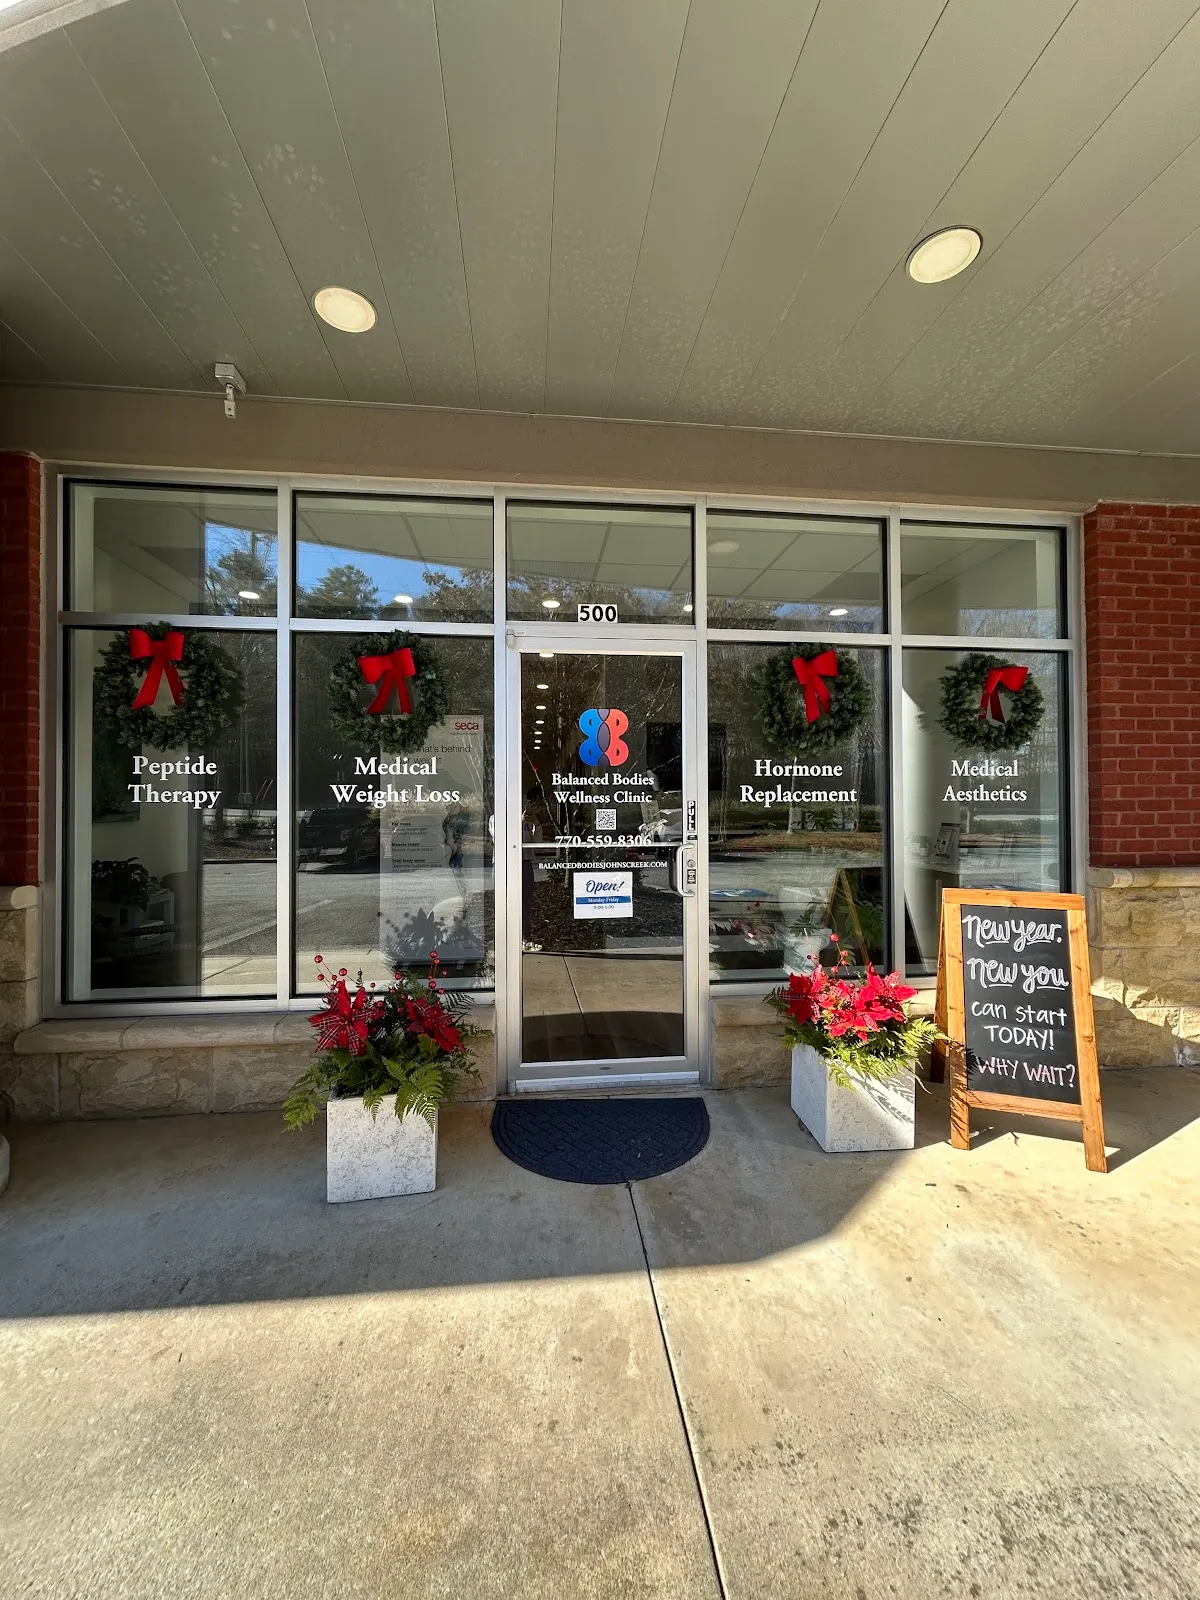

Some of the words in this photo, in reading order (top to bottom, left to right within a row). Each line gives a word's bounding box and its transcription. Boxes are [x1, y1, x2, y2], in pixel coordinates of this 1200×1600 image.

[580, 605, 616, 622] 500
[454, 722, 479, 730] seca
[414, 744, 439, 753] hat's
[441, 744, 471, 753] behind
[132, 755, 217, 781] Peptide
[354, 756, 437, 775] Medical
[754, 759, 843, 777] Hormone
[951, 760, 1019, 777] Medical
[551, 773, 609, 785] Balanced
[612, 773, 654, 785] Bodies
[127, 783, 222, 809] Therapy
[329, 784, 409, 808] Weight
[415, 784, 460, 803] Loss
[553, 791, 610, 803] Wellness
[613, 791, 652, 803] Clinic
[740, 784, 857, 807] Replacement
[942, 784, 1027, 801] Aesthetics
[555, 835, 652, 848] 770-559-8306
[538, 861, 668, 870] BALANCEDBODIESJOHNSCREEK.COM
[586, 880, 625, 894] Open!
[1020, 966, 1070, 994] you
[971, 1001, 1007, 1020] can
[1016, 1005, 1067, 1027] start
[983, 1025, 1054, 1050] TODAY!
[976, 1056, 1018, 1079] WHY
[1023, 1062, 1076, 1088] WAIT?
